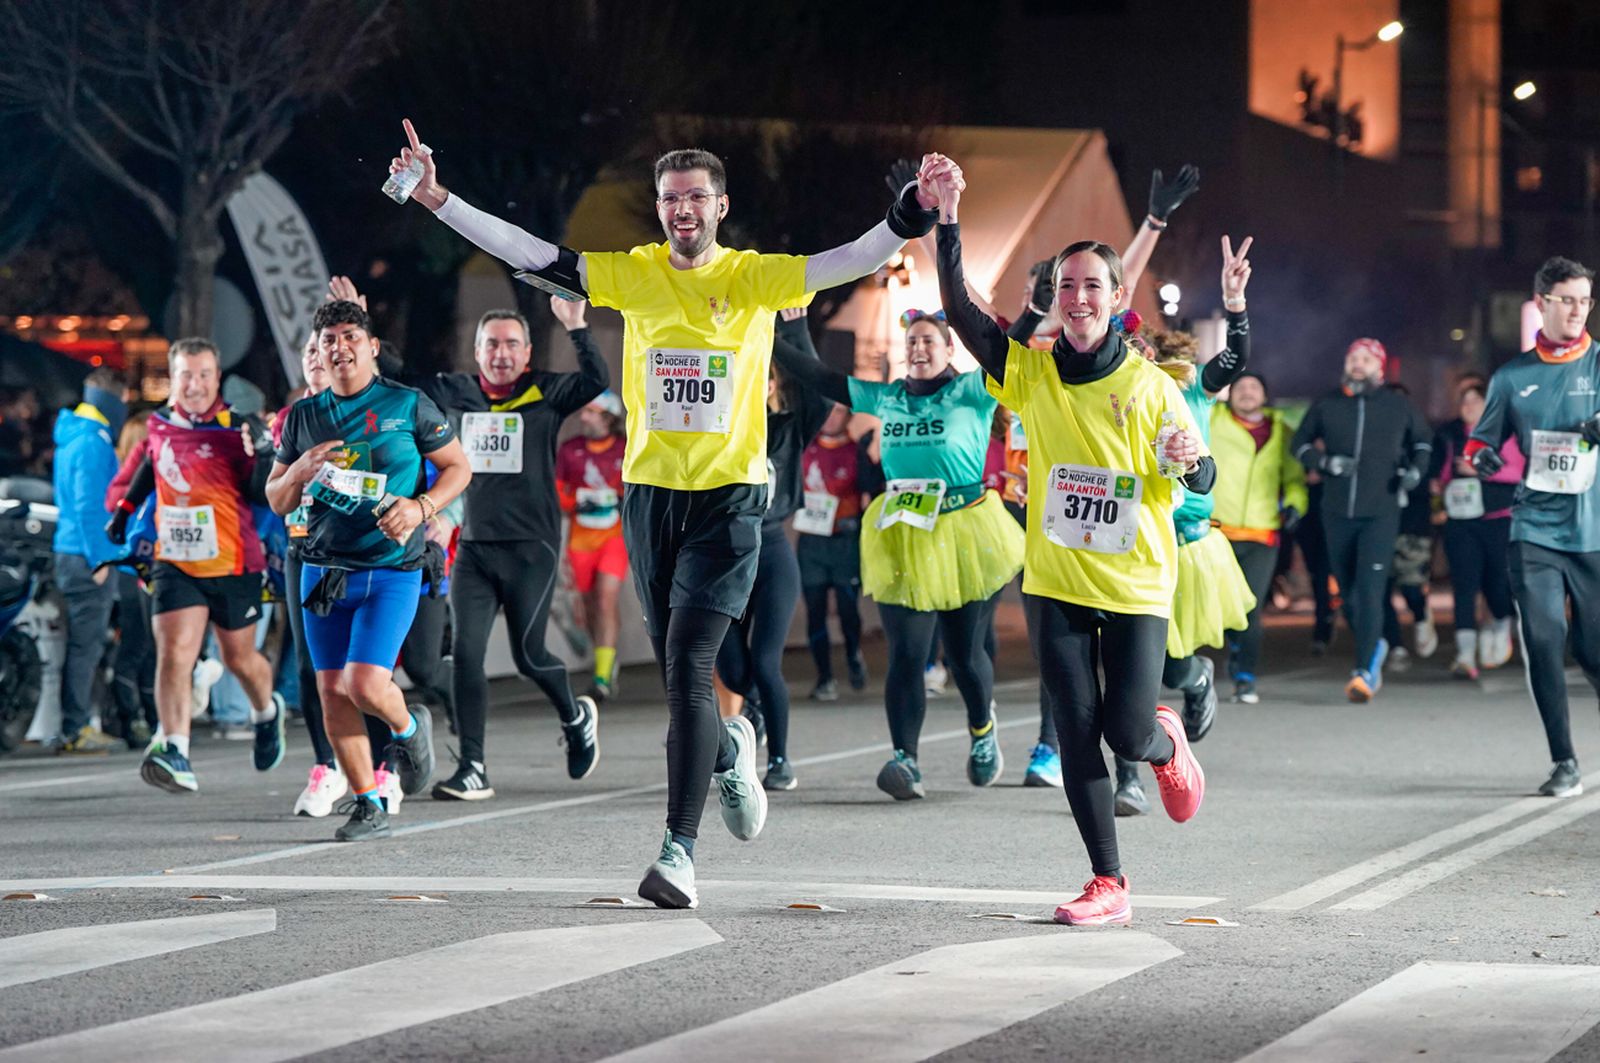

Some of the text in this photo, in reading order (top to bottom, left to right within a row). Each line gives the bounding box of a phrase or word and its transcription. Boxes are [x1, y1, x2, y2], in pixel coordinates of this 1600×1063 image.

[664, 358, 701, 367] NOCHE DE
[655, 367, 670, 377] SAN
[663, 378, 715, 404] 3709
[883, 417, 945, 437] serás
[1548, 454, 1577, 471] 667
[1057, 482, 1075, 493] SAN
[1069, 473, 1095, 484] NOCHE
[1096, 477, 1108, 486] DE
[1064, 494, 1119, 525] 3710
[169, 527, 204, 543] 1952
